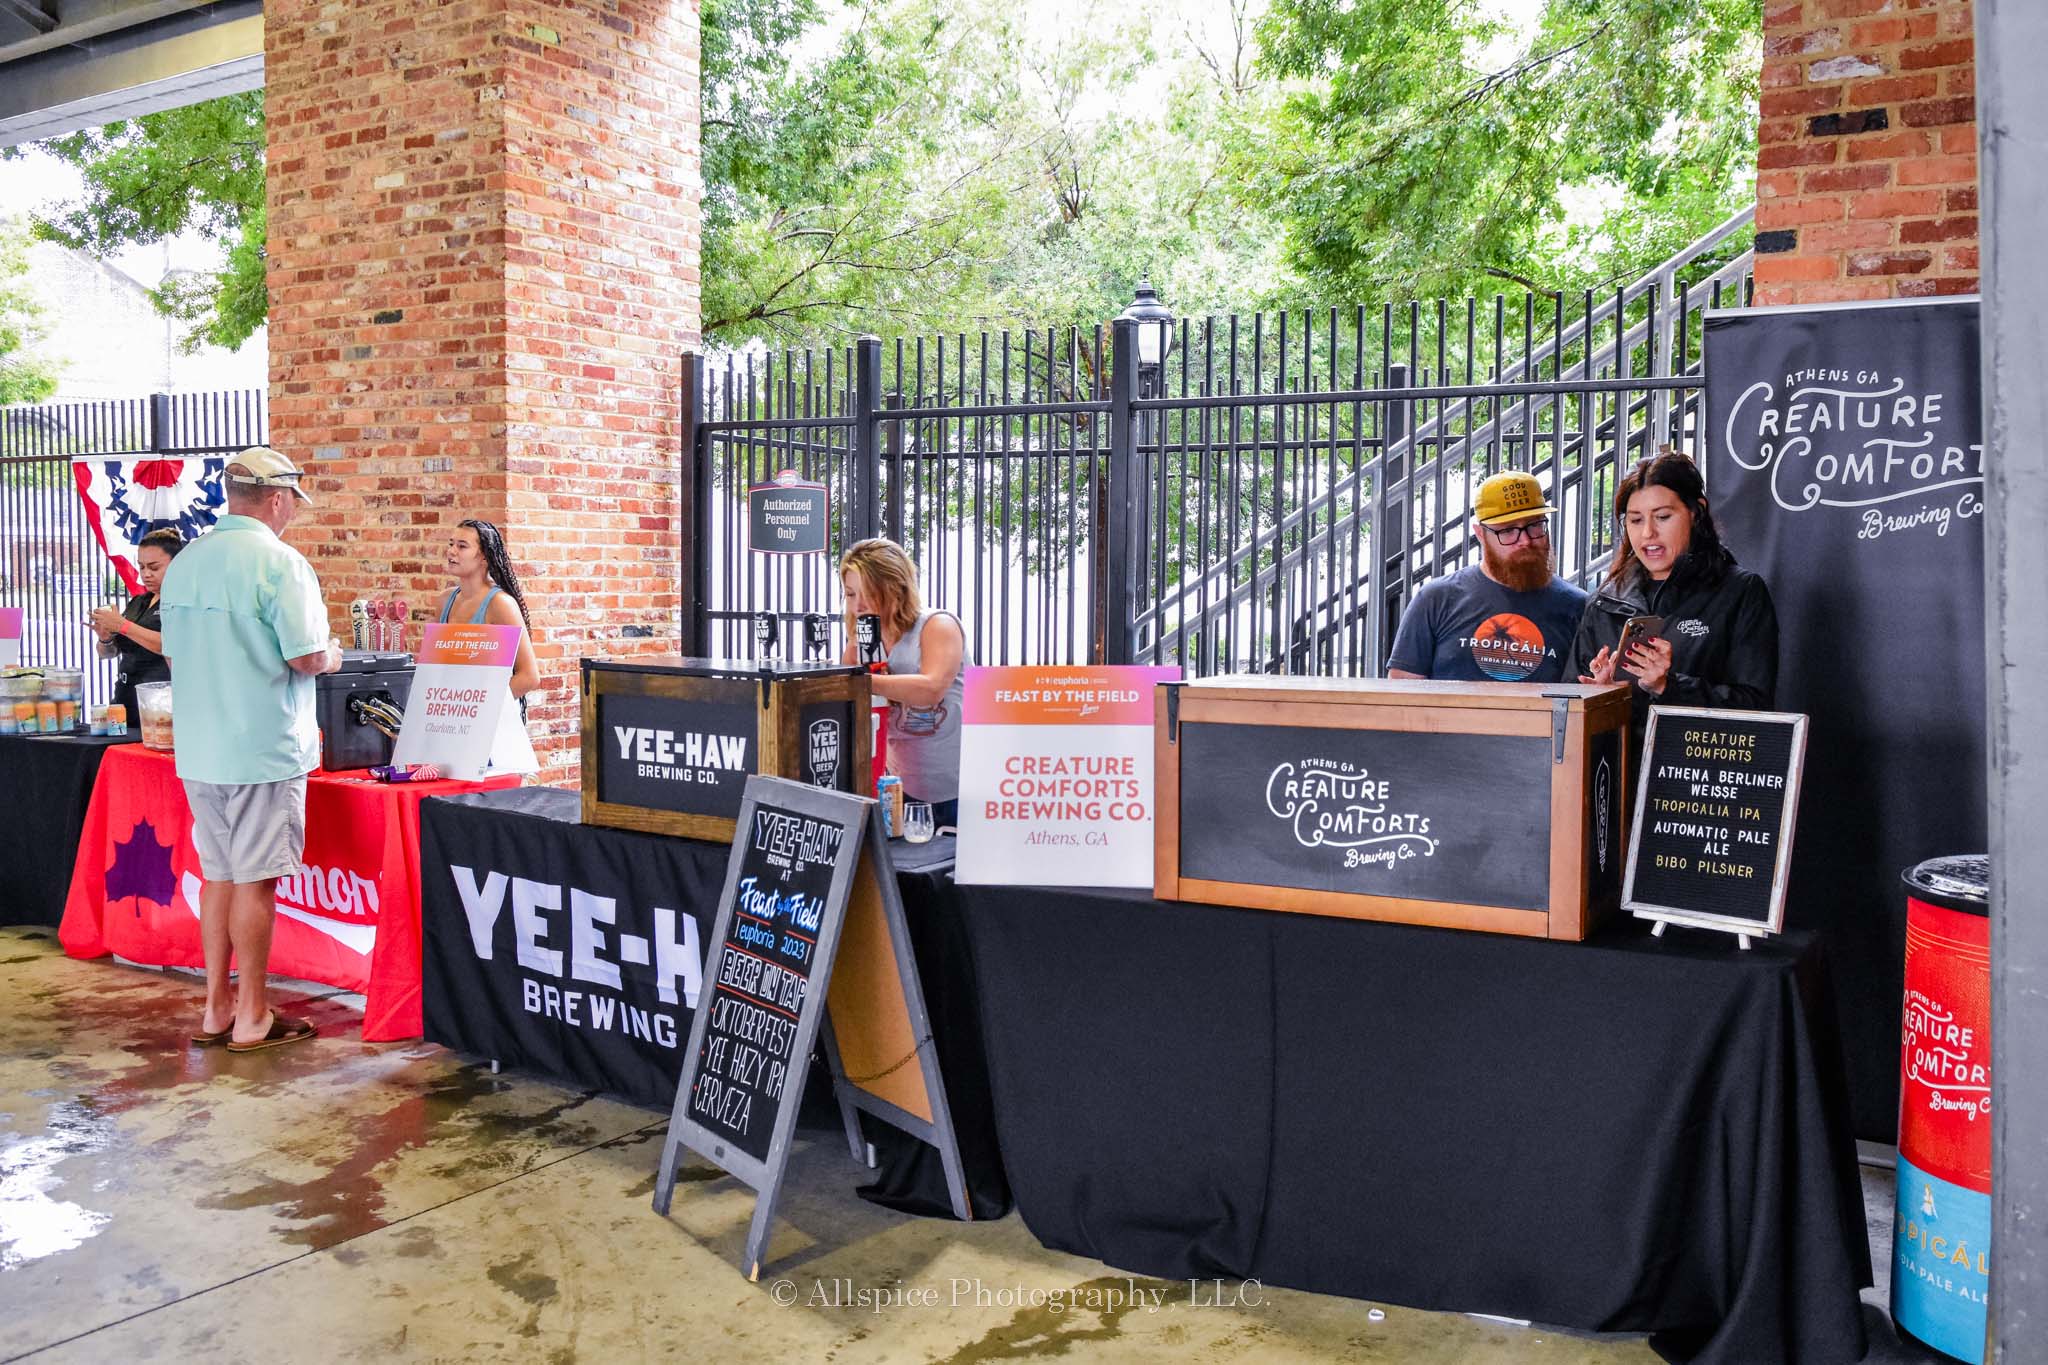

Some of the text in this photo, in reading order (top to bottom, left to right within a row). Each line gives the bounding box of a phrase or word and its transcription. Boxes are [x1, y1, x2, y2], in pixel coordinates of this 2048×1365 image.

[1785, 368, 1879, 388] ATHENS GA
[1726, 377, 1943, 471] CREATURE
[1771, 431, 1985, 511] COMFORT
[1503, 482, 1526, 492] GOOD
[1504, 490, 1528, 500] COLD
[763, 499, 812, 511] Authorized
[765, 513, 810, 525] Personnel
[1857, 507, 1951, 539] Brewing
[777, 527, 797, 541] Only
[435, 640, 499, 650] FEAST BY THE FIELD
[1459, 637, 1557, 659] TROPICÁLIA
[426, 687, 487, 703] SYCAMORE
[995, 690, 1139, 703] FEAST BY THE FIELD
[426, 703, 478, 719] BREWING
[614, 726, 746, 772] YEE-HAW
[812, 730, 837, 747] YEE
[1684, 730, 1756, 747] CREATURE
[813, 745, 836, 763] HAW
[1686, 746, 1752, 762] COMFORTS
[638, 764, 719, 785] BREWING CO.
[816, 762, 833, 773] BEER
[1005, 756, 1134, 775] CREATURE
[1301, 758, 1354, 772] ATHENS GA
[1000, 778, 1139, 798] COMFORTS
[1658, 766, 1783, 789] ATHENA BERLINER
[1266, 762, 1389, 818] CREATURE
[1691, 784, 1738, 799] WEISSE
[985, 801, 1152, 821] BREWING CO.
[1654, 798, 1760, 821] TROPICALIA IPA
[1294, 799, 1431, 847] COMFORTS
[1654, 821, 1770, 845] AUTOMATIC PALE
[756, 811, 844, 866] YEE-HAW
[1025, 830, 1108, 847] Athens, GA
[1704, 842, 1730, 855] ALE
[766, 853, 791, 869] BREWING
[1344, 844, 1416, 869] Brewing Co.
[1656, 855, 1753, 879] BIBO PILSNER
[780, 869, 792, 882] AT
[740, 877, 780, 918] Feast
[790, 893, 823, 932] Field
[450, 864, 703, 1009] YEE-H
[739, 922, 805, 960] euphoria 2023
[719, 948, 808, 1013] BEER ON TAP
[523, 978, 677, 1048] BREWING
[1931, 1001, 1942, 1012] GA
[712, 996, 797, 1059] OKTOBERFEST
[1902, 989, 1974, 1048] CREATURE
[1906, 1031, 1991, 1083] COMFOR
[706, 1035, 786, 1101] YEE HAZY IPA
[695, 1073, 752, 1136] CERVEZA
[1930, 1090, 1976, 1120] Brewing
[1920, 1267, 1952, 1292] PALE
